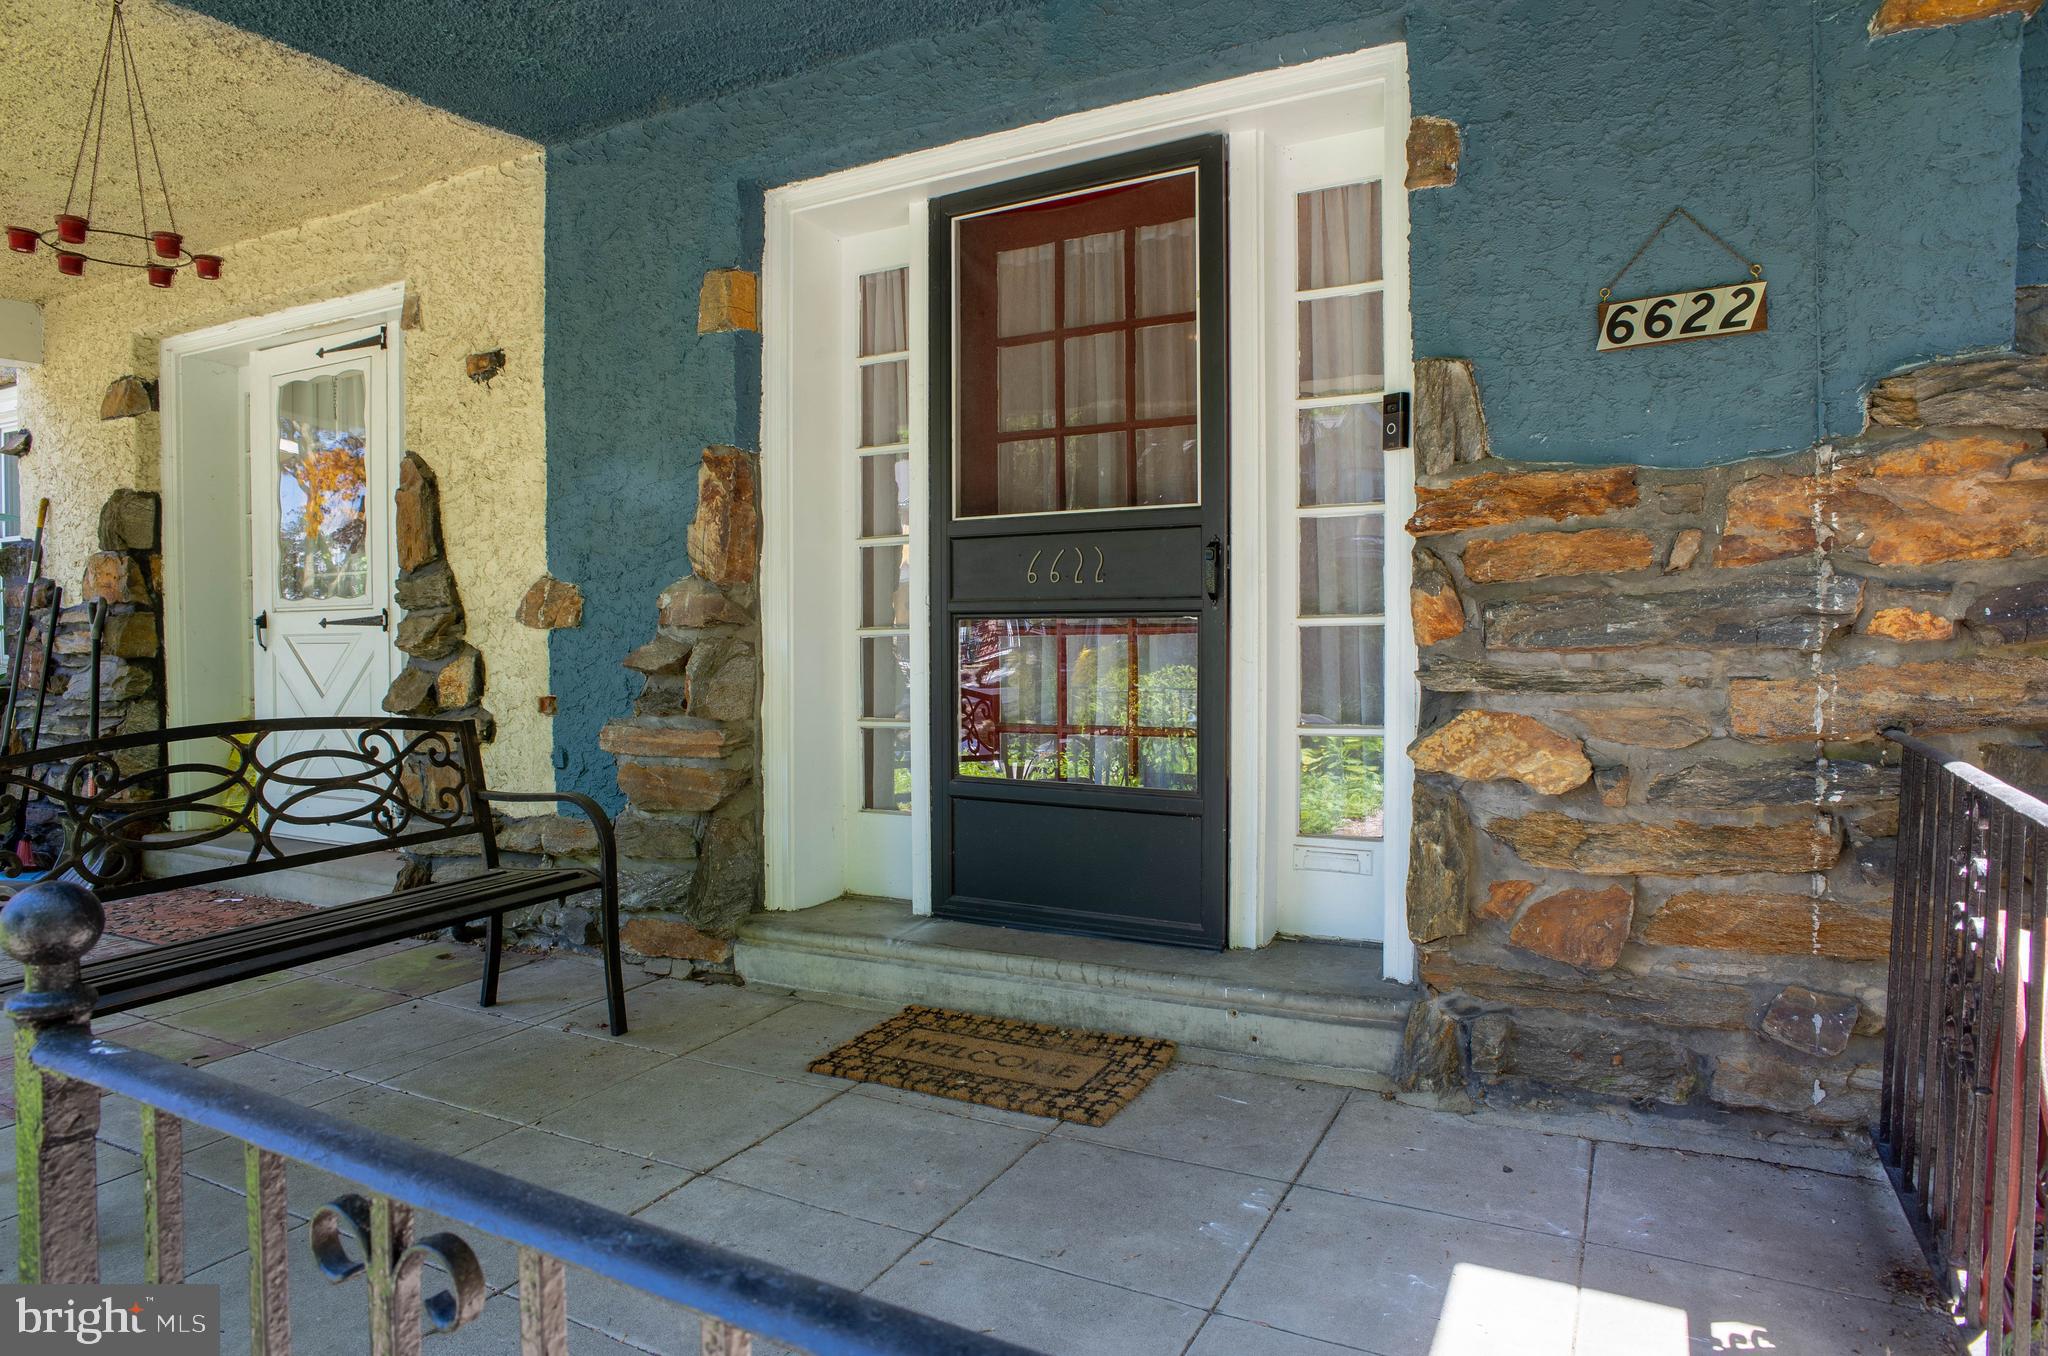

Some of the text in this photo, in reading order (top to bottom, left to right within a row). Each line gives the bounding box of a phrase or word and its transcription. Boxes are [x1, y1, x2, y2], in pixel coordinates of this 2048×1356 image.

[1606, 286, 1756, 345] 6622
[1027, 546, 1104, 584] 6622
[903, 1038, 1082, 1079] WELCOME
